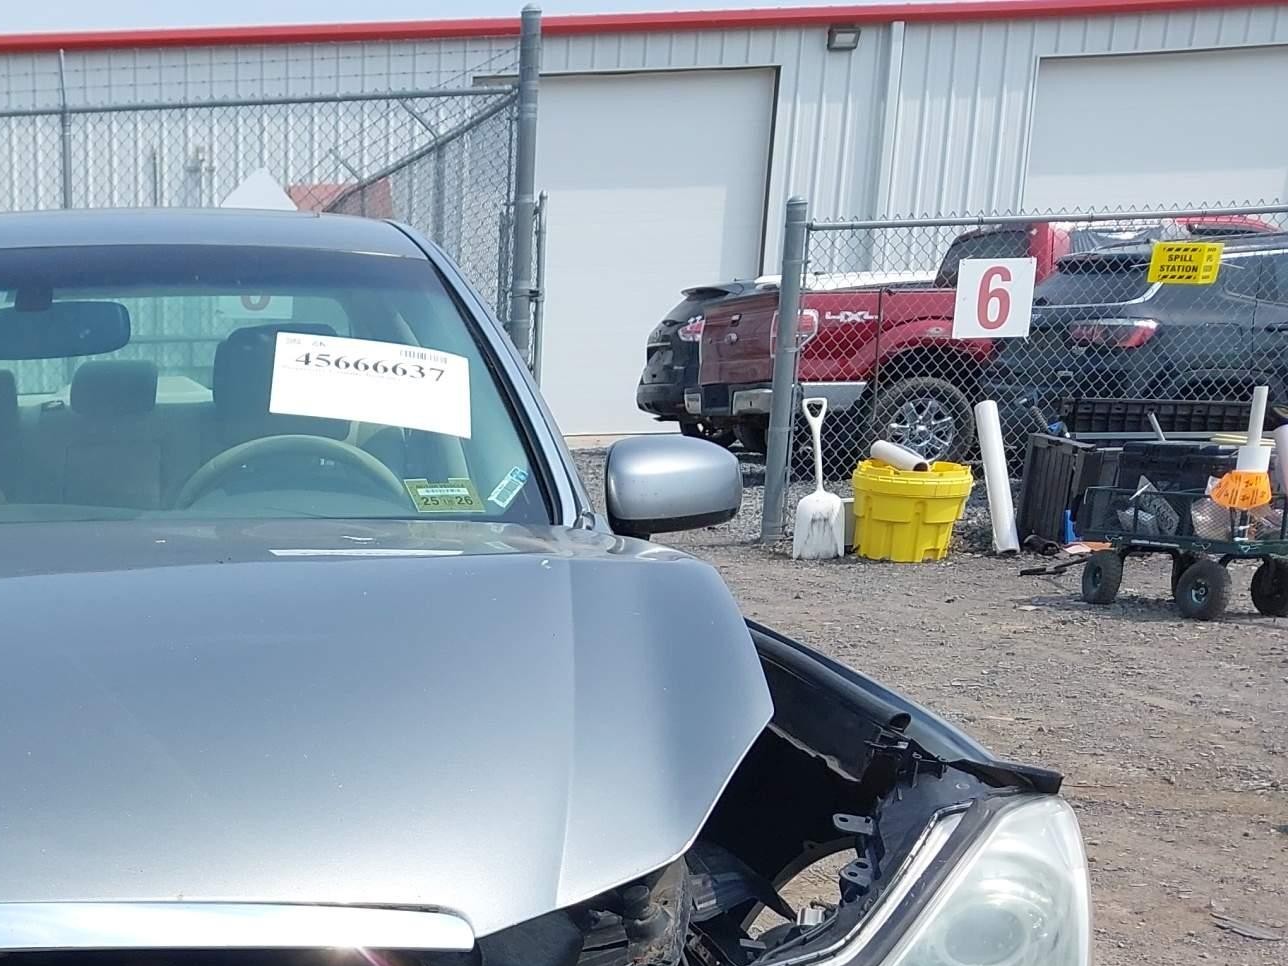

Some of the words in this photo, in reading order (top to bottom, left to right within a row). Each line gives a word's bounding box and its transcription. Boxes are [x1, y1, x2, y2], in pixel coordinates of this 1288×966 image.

[1167, 254, 1193, 262] SPILL
[1159, 264, 1198, 273] STATION
[977, 265, 1012, 330] 6
[295, 352, 446, 382] 45666637
[421, 496, 440, 506] 25
[455, 495, 474, 506] 26
